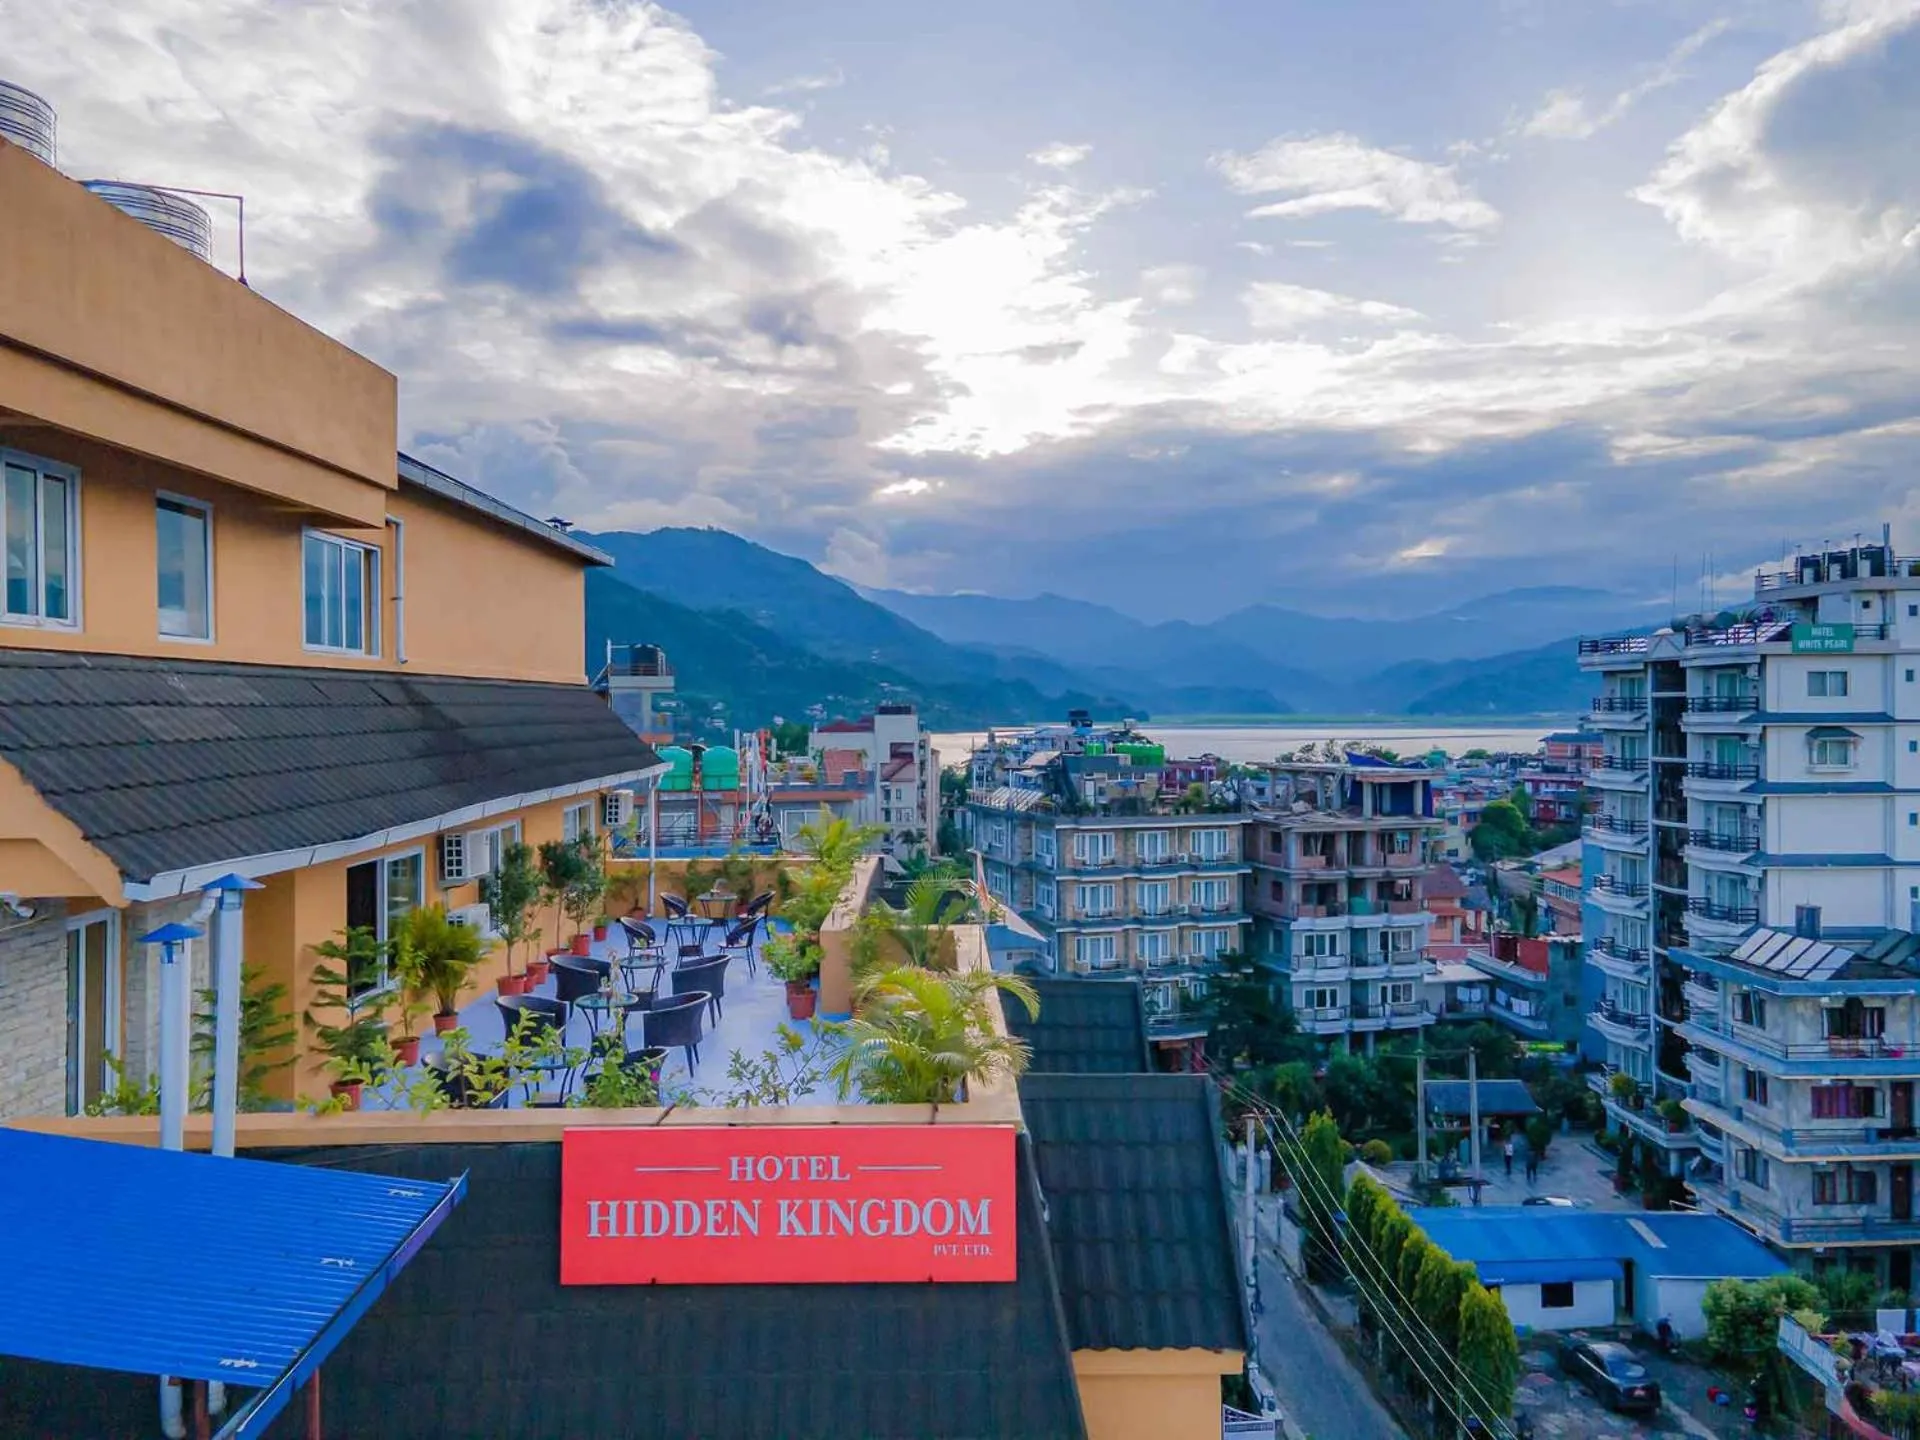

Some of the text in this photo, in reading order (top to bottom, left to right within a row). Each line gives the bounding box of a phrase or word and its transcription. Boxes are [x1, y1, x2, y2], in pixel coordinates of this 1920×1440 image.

[1811, 627, 1833, 637] HOTEL
[1798, 639, 1848, 649] WHITE PEARL
[729, 1155, 850, 1182] HOTEL
[586, 1198, 993, 1237] HIDDEN KINGDOM
[964, 1244, 992, 1256] LTD.
